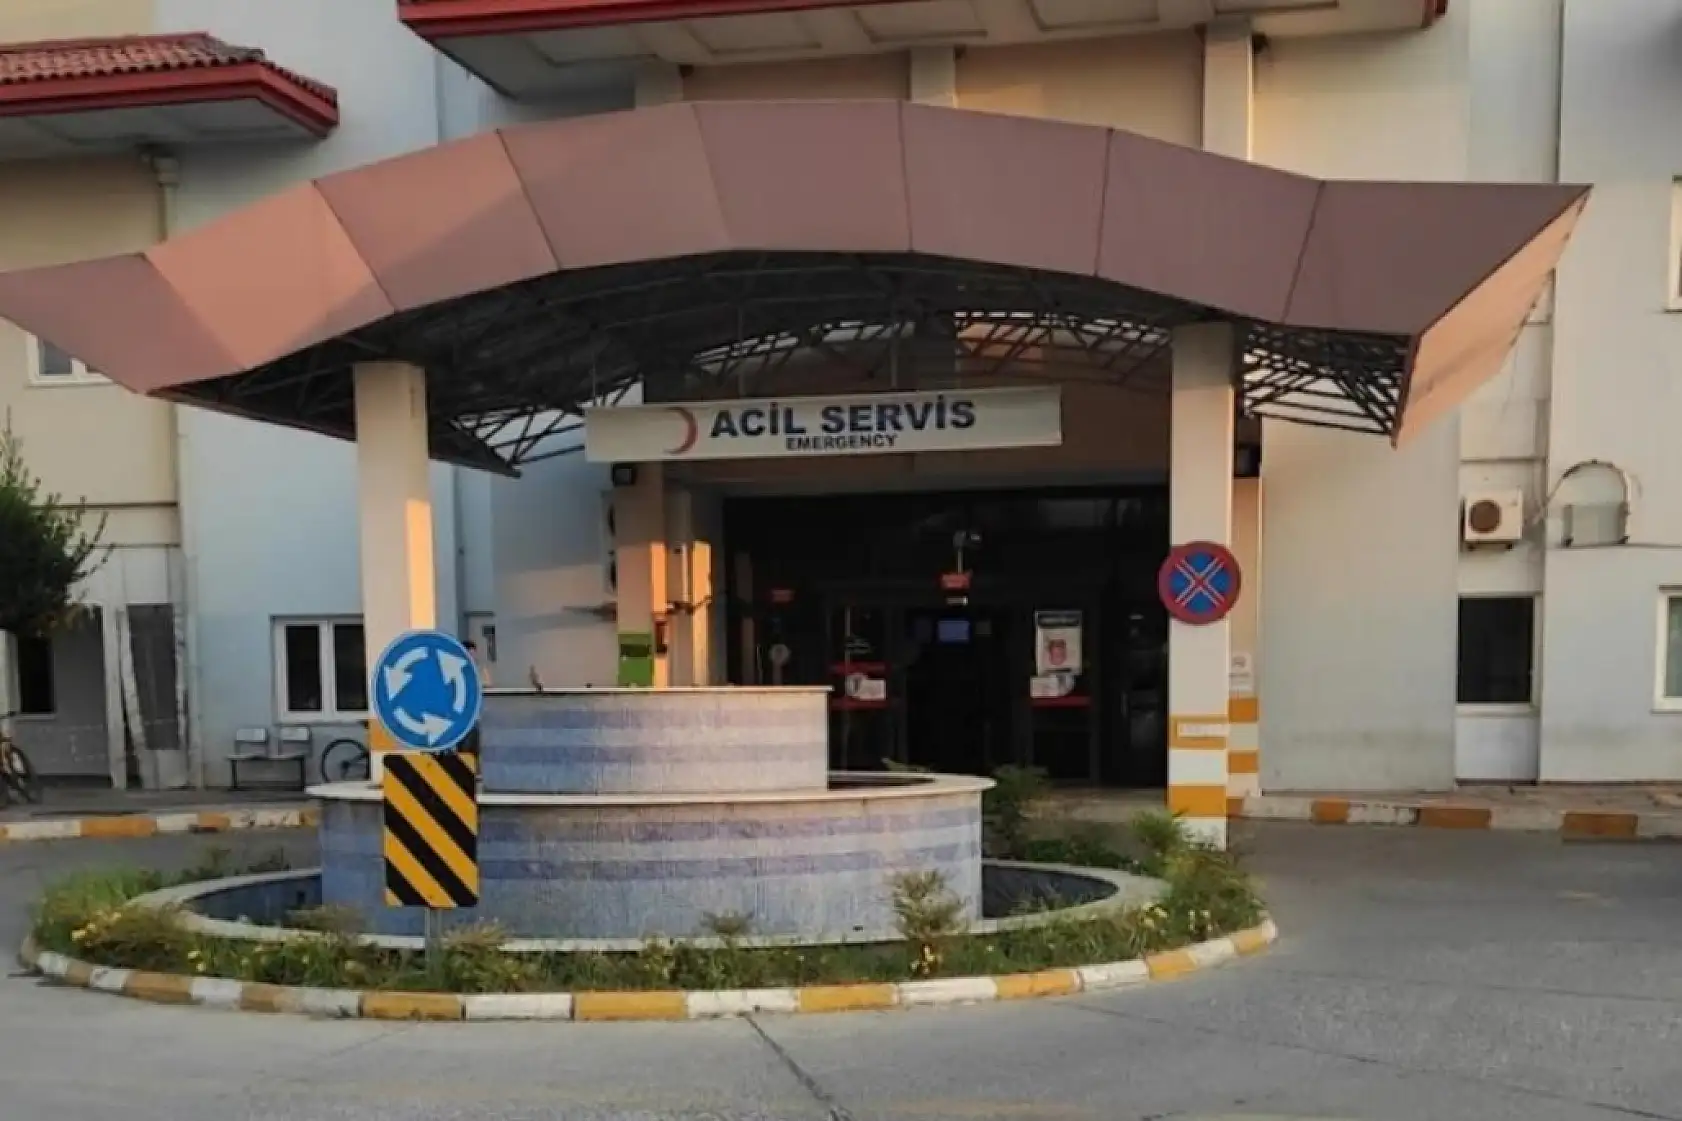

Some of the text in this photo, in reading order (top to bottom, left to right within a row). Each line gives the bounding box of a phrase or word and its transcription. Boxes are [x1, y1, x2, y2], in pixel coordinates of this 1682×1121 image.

[710, 395, 976, 438] ACİL SERVİS
[786, 433, 897, 452] EMERGENCY
